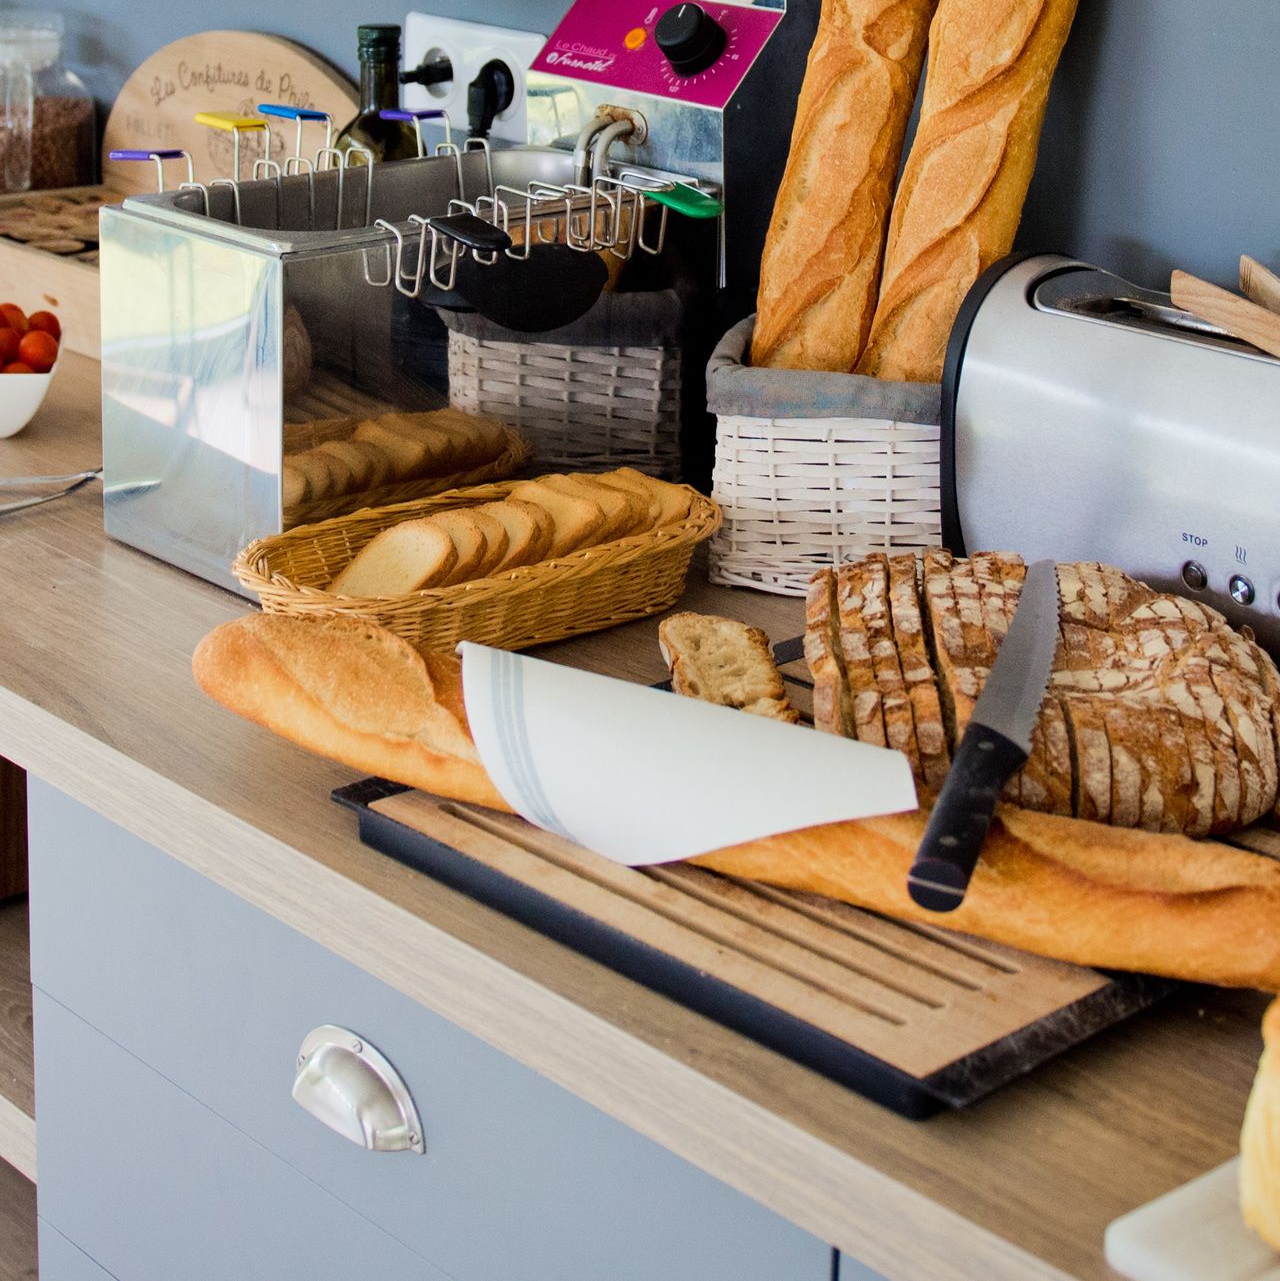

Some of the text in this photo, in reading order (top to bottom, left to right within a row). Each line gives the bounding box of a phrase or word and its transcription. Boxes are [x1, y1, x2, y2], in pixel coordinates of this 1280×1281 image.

[151, 76, 175, 106] Les
[177, 61, 250, 93] Confitures
[255, 69, 272, 94] de
[1182, 532, 1208, 547] STOP
